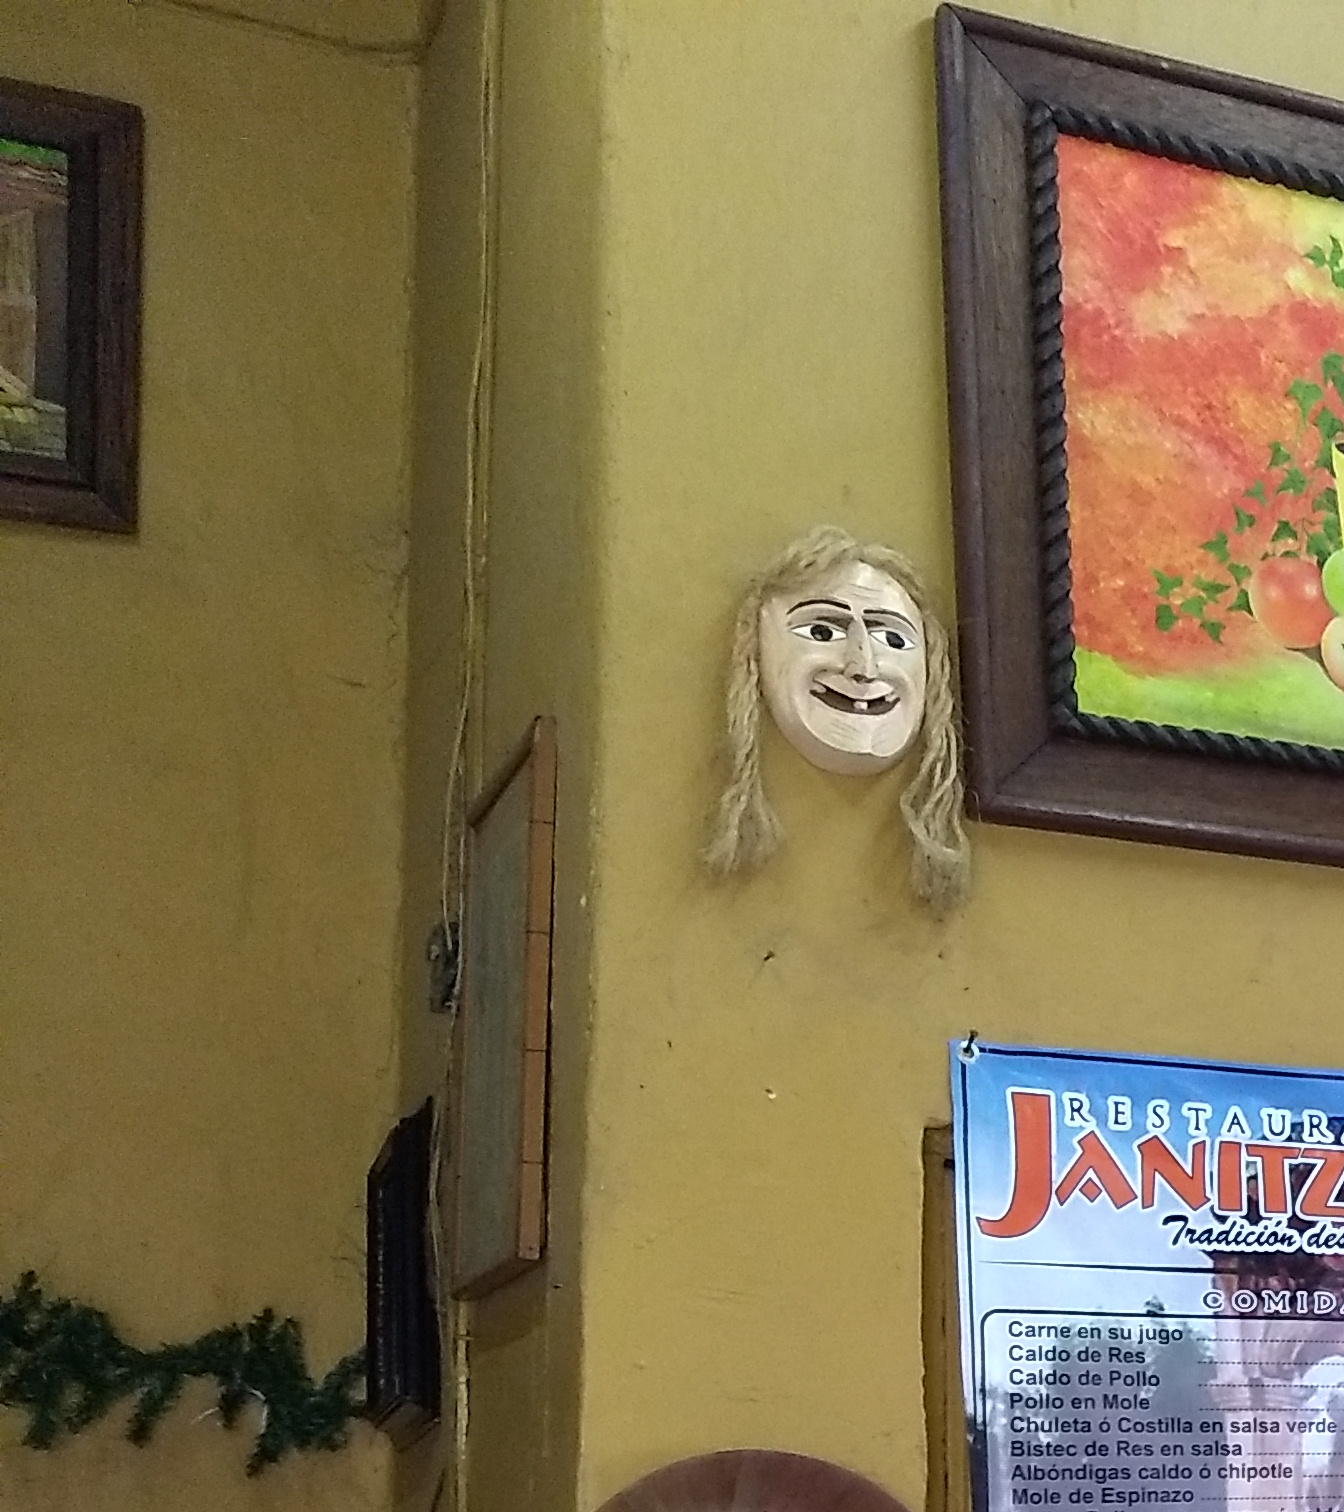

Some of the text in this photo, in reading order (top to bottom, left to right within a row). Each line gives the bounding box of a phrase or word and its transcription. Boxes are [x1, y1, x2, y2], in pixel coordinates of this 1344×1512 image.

[1162, 1214, 1297, 1248] Tradición
[1008, 1320, 1071, 1338] Carne
[1078, 1326, 1101, 1339] en
[1108, 1327, 1131, 1340] su
[1137, 1324, 1183, 1345] jugo
[1009, 1345, 1071, 1362] Caldo
[1077, 1346, 1102, 1363] de
[1108, 1347, 1146, 1364] Res
[1009, 1369, 1071, 1386] Caldo
[1078, 1370, 1102, 1386] de
[1109, 1370, 1160, 1387] Pollo
[1009, 1392, 1064, 1410] Pollo
[1071, 1396, 1095, 1410] en
[1103, 1393, 1150, 1410] Mole
[1010, 1416, 1091, 1433] Chuleta
[1099, 1417, 1111, 1433] ó
[1118, 1417, 1193, 1433] Costilla
[1199, 1420, 1223, 1433] en
[1230, 1417, 1280, 1433] salsa
[1286, 1417, 1337, 1433] verde
[1010, 1440, 1077, 1457] Bistec
[1084, 1441, 1109, 1457] de
[1116, 1440, 1154, 1457] Res
[1160, 1444, 1184, 1456] en
[1190, 1441, 1242, 1456] salsa
[1011, 1464, 1131, 1484] Albóndigas
[1138, 1464, 1192, 1480] caldo
[1199, 1463, 1211, 1479] ó
[1217, 1463, 1293, 1482] chipotle
[1012, 1488, 1061, 1505] Mole
[1069, 1488, 1094, 1504] de
[1101, 1487, 1194, 1507] Espinazo
